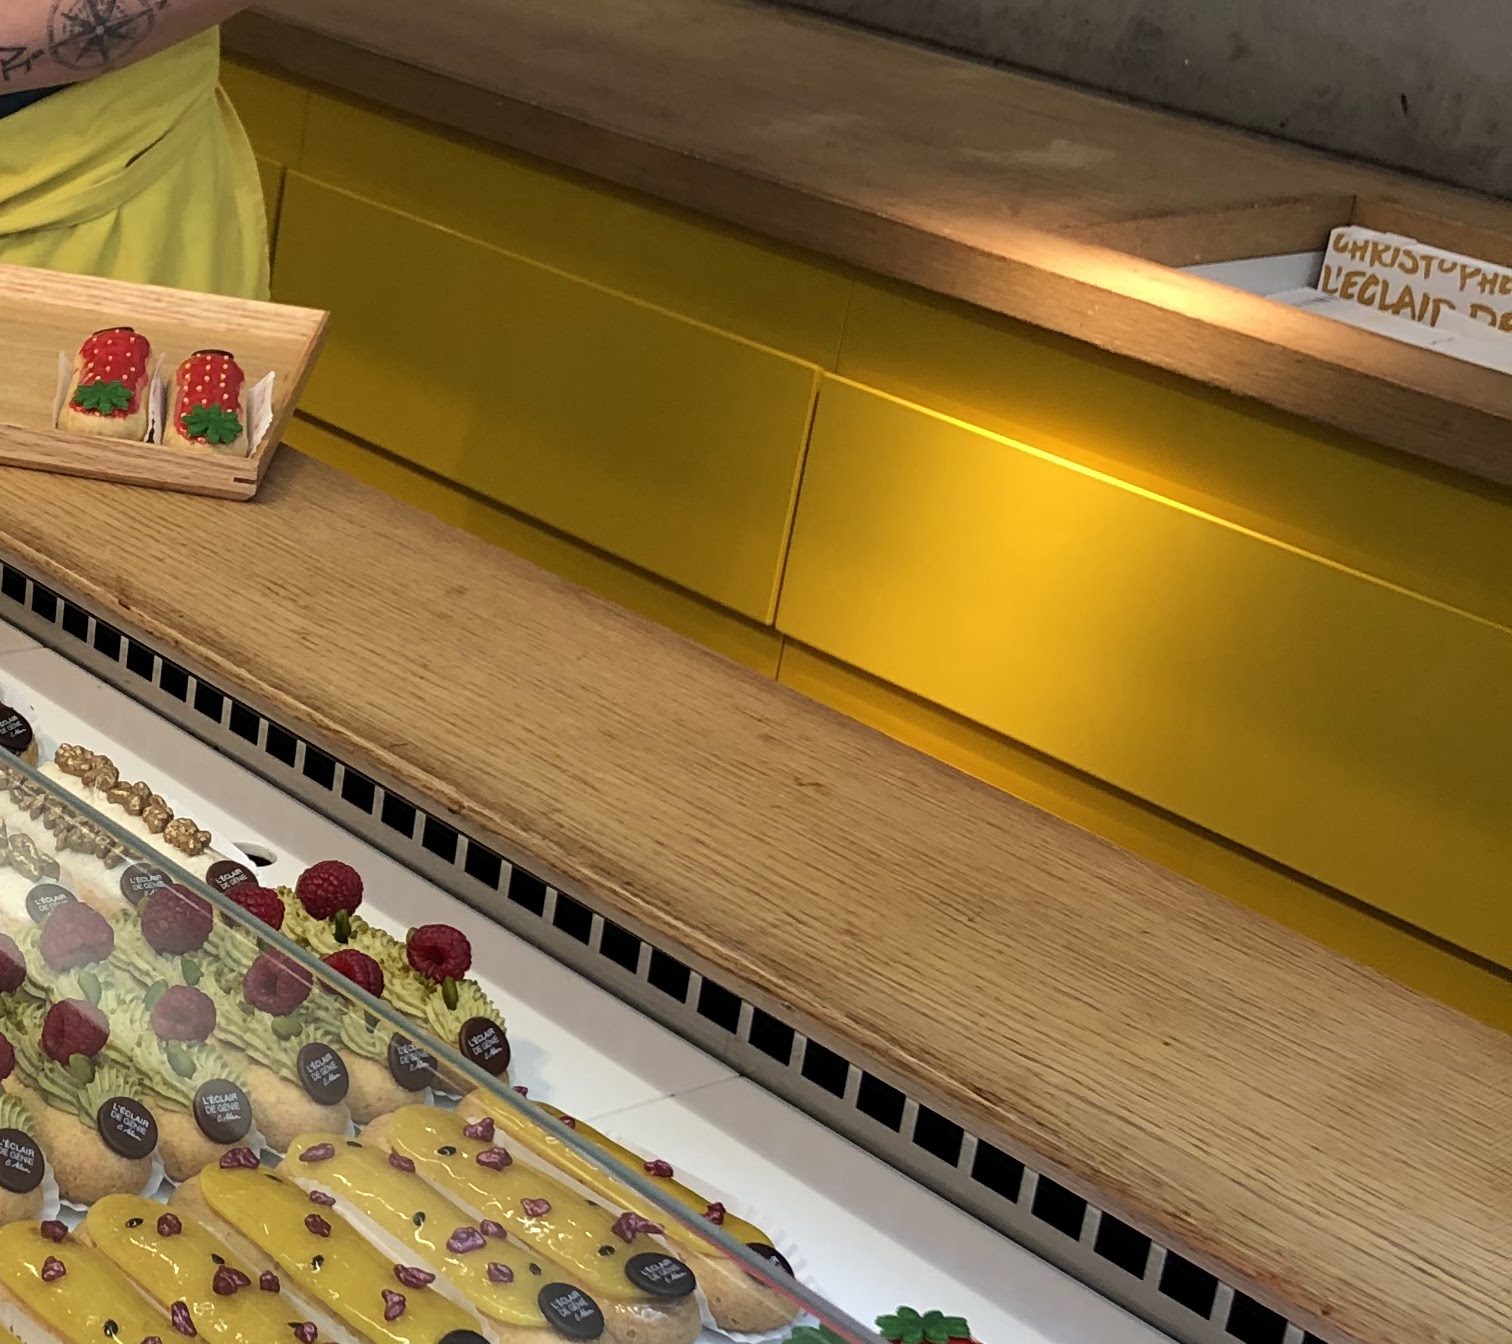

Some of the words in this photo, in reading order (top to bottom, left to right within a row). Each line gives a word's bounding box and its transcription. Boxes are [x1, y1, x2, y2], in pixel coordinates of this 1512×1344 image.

[203, 1092, 237, 1103] L'ÉCLAIR
[204, 1104, 216, 1112] DE
[109, 1111, 123, 1122] DE
[112, 1103, 150, 1125] L'ÉCLAIR
